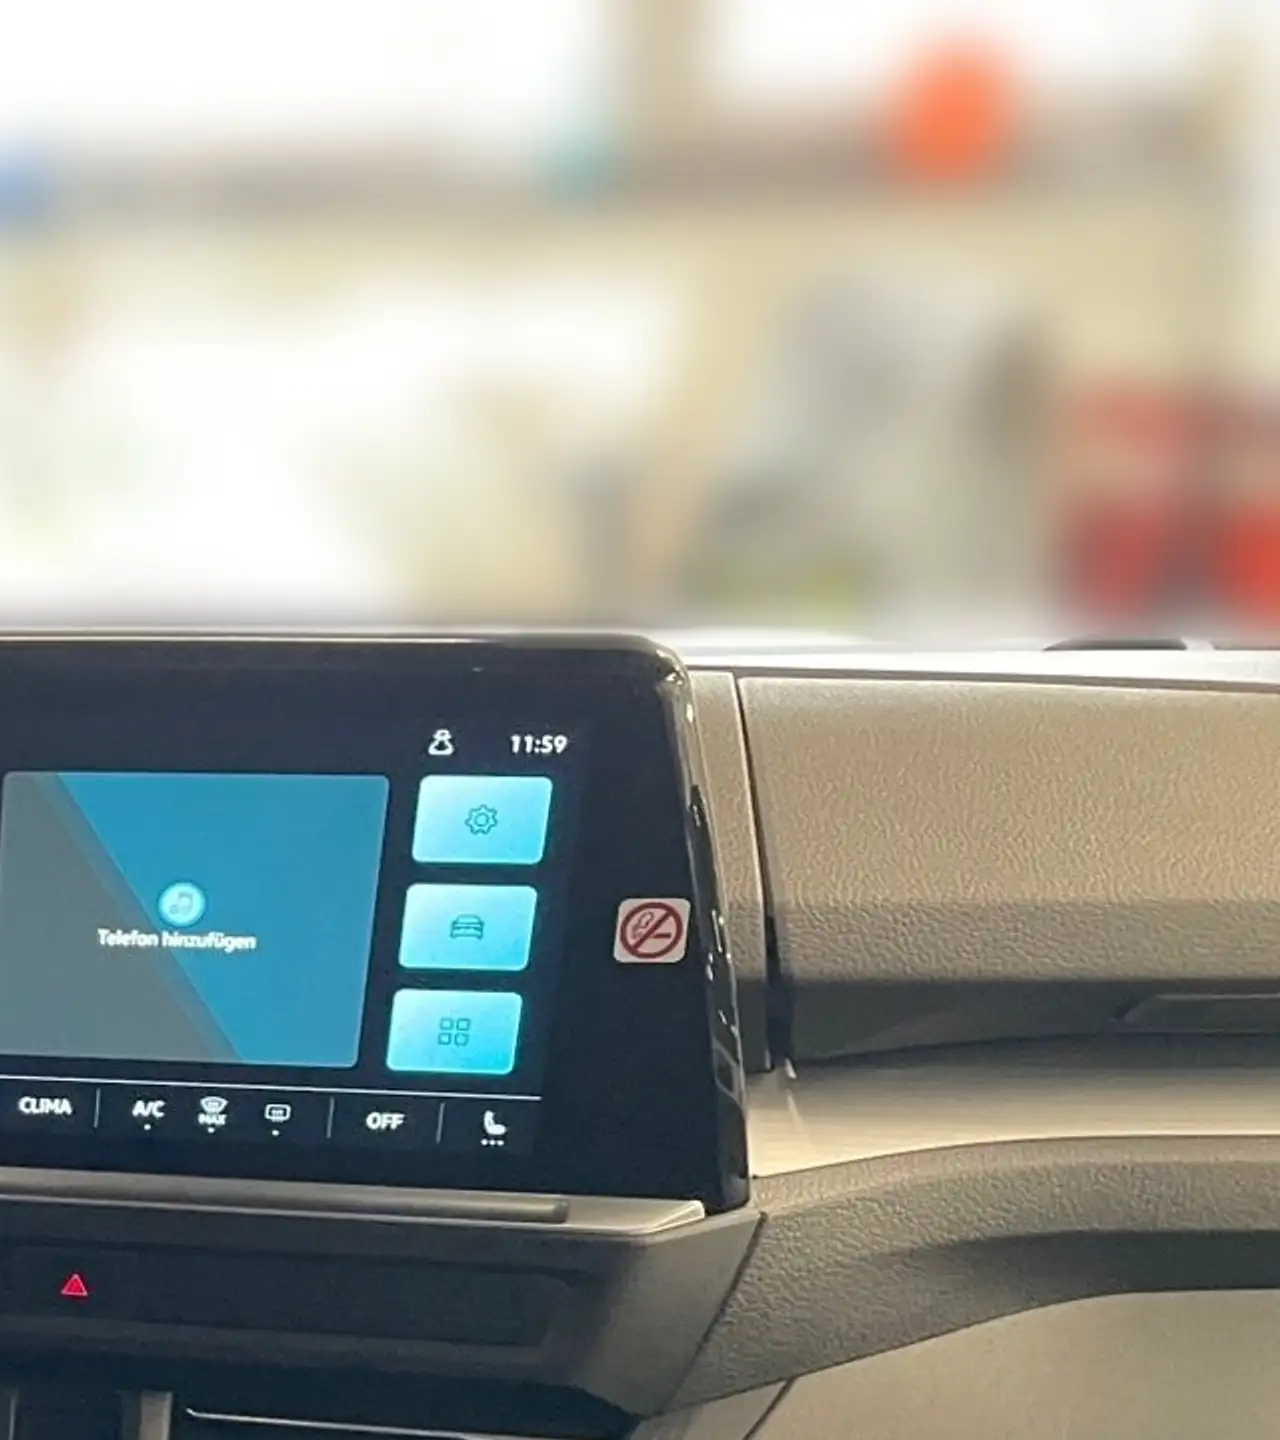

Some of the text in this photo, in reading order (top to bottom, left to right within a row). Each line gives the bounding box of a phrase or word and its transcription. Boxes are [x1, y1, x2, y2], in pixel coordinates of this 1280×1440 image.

[511, 734, 568, 754] 11:59
[97, 928, 257, 954] Telefon hinzufügen
[18, 1096, 72, 1116] CLIMA
[132, 1100, 165, 1118] A/C
[365, 1111, 405, 1130] OFF
